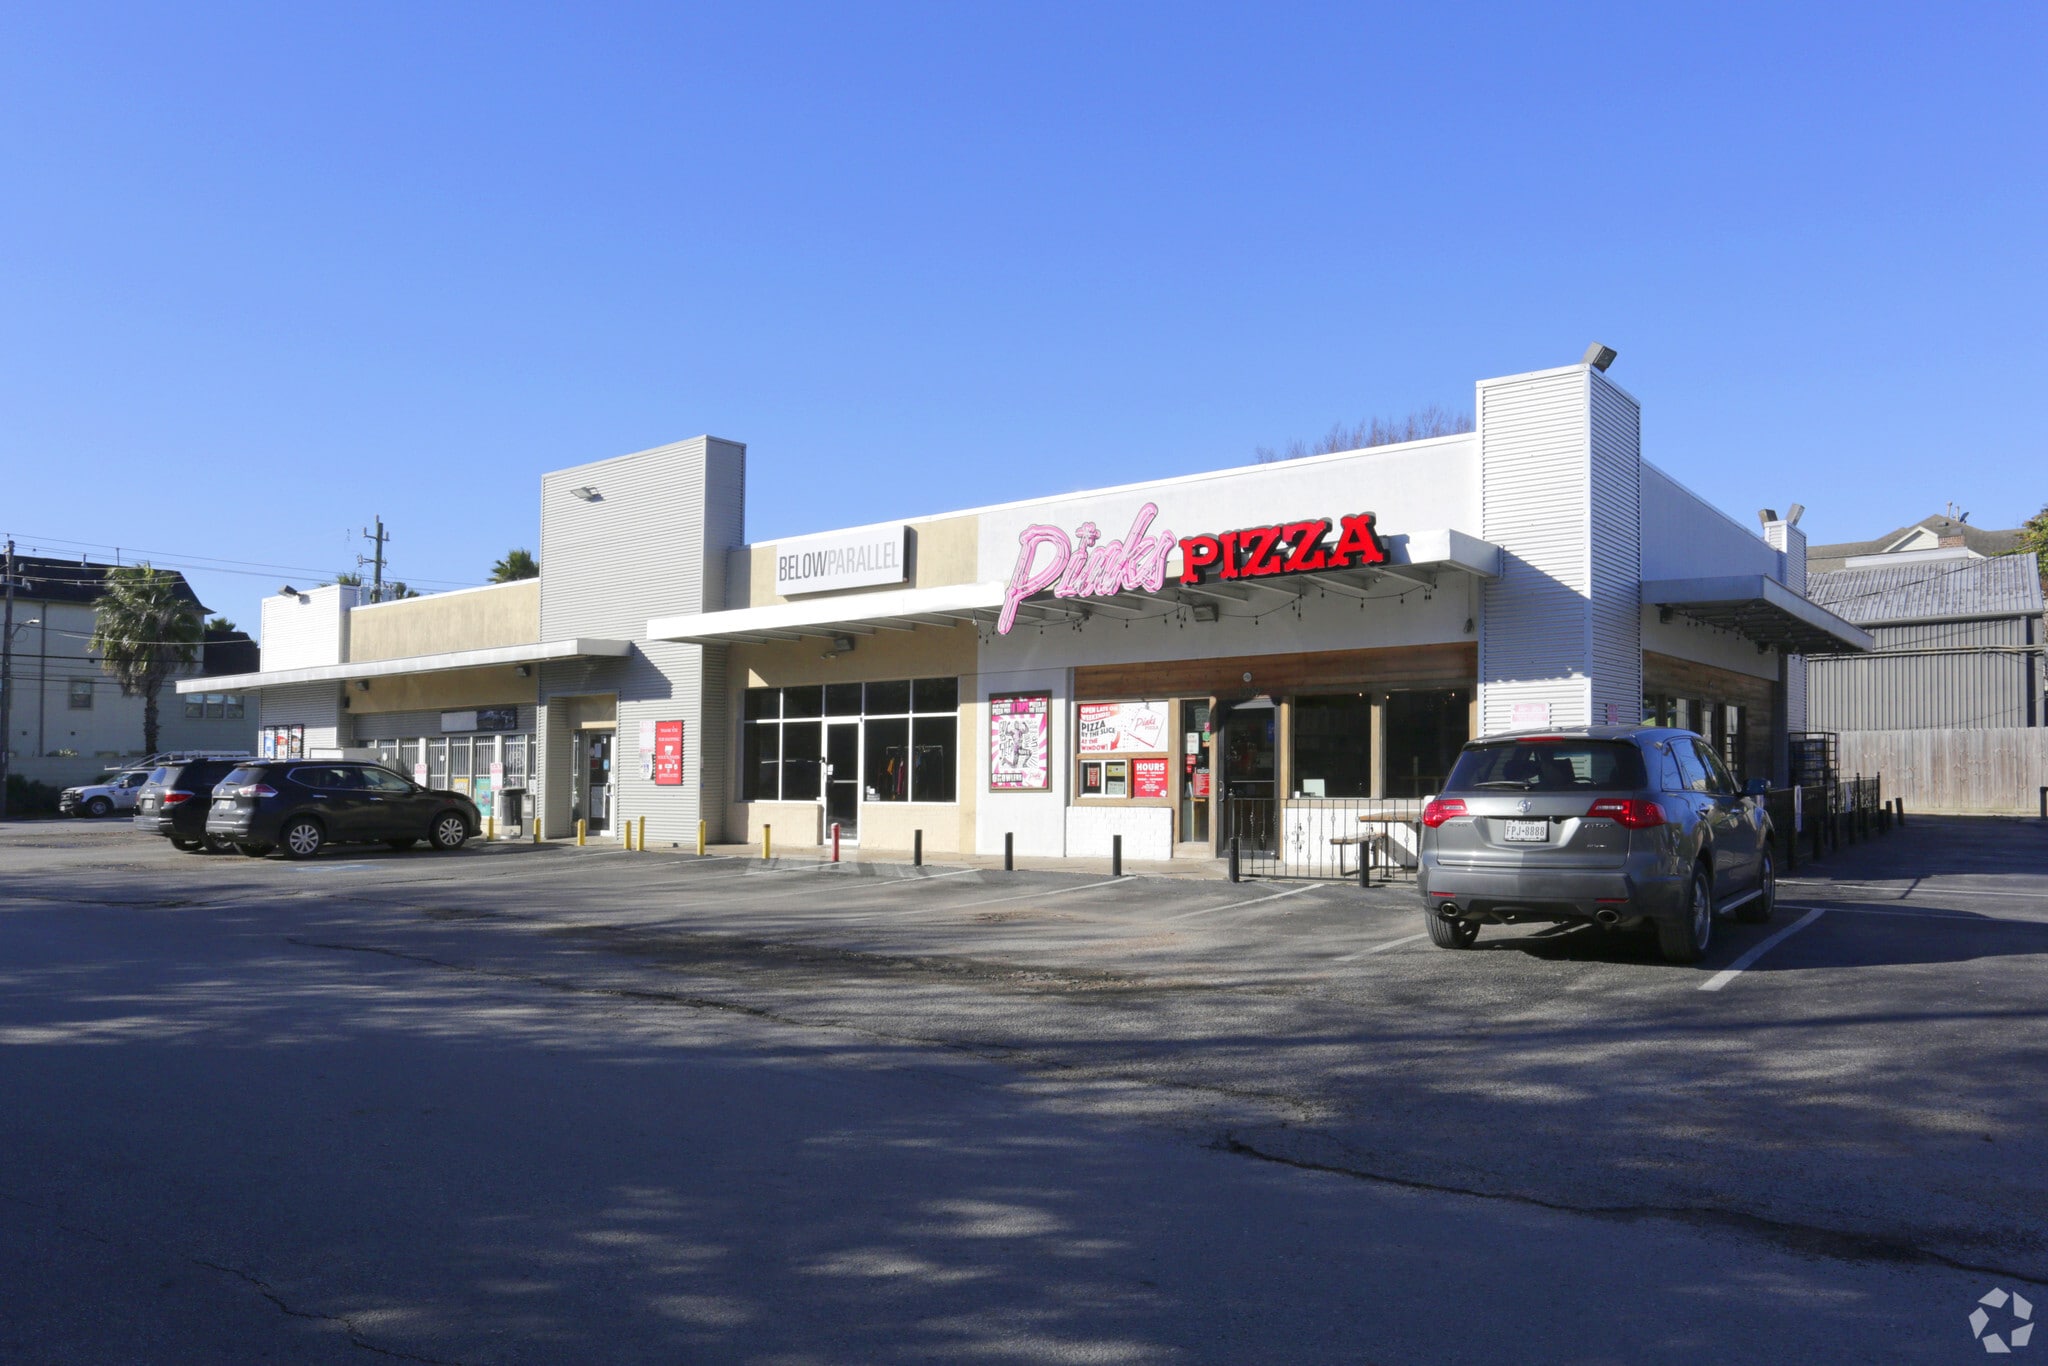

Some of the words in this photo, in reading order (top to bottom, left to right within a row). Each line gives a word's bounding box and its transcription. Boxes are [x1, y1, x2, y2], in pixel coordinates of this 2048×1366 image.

[1179, 513, 1386, 585] PIZZA
[1081, 720, 1106, 732] PIZZA
[1100, 727, 1115, 735] SLICE
[1136, 762, 1165, 771] HOURS
